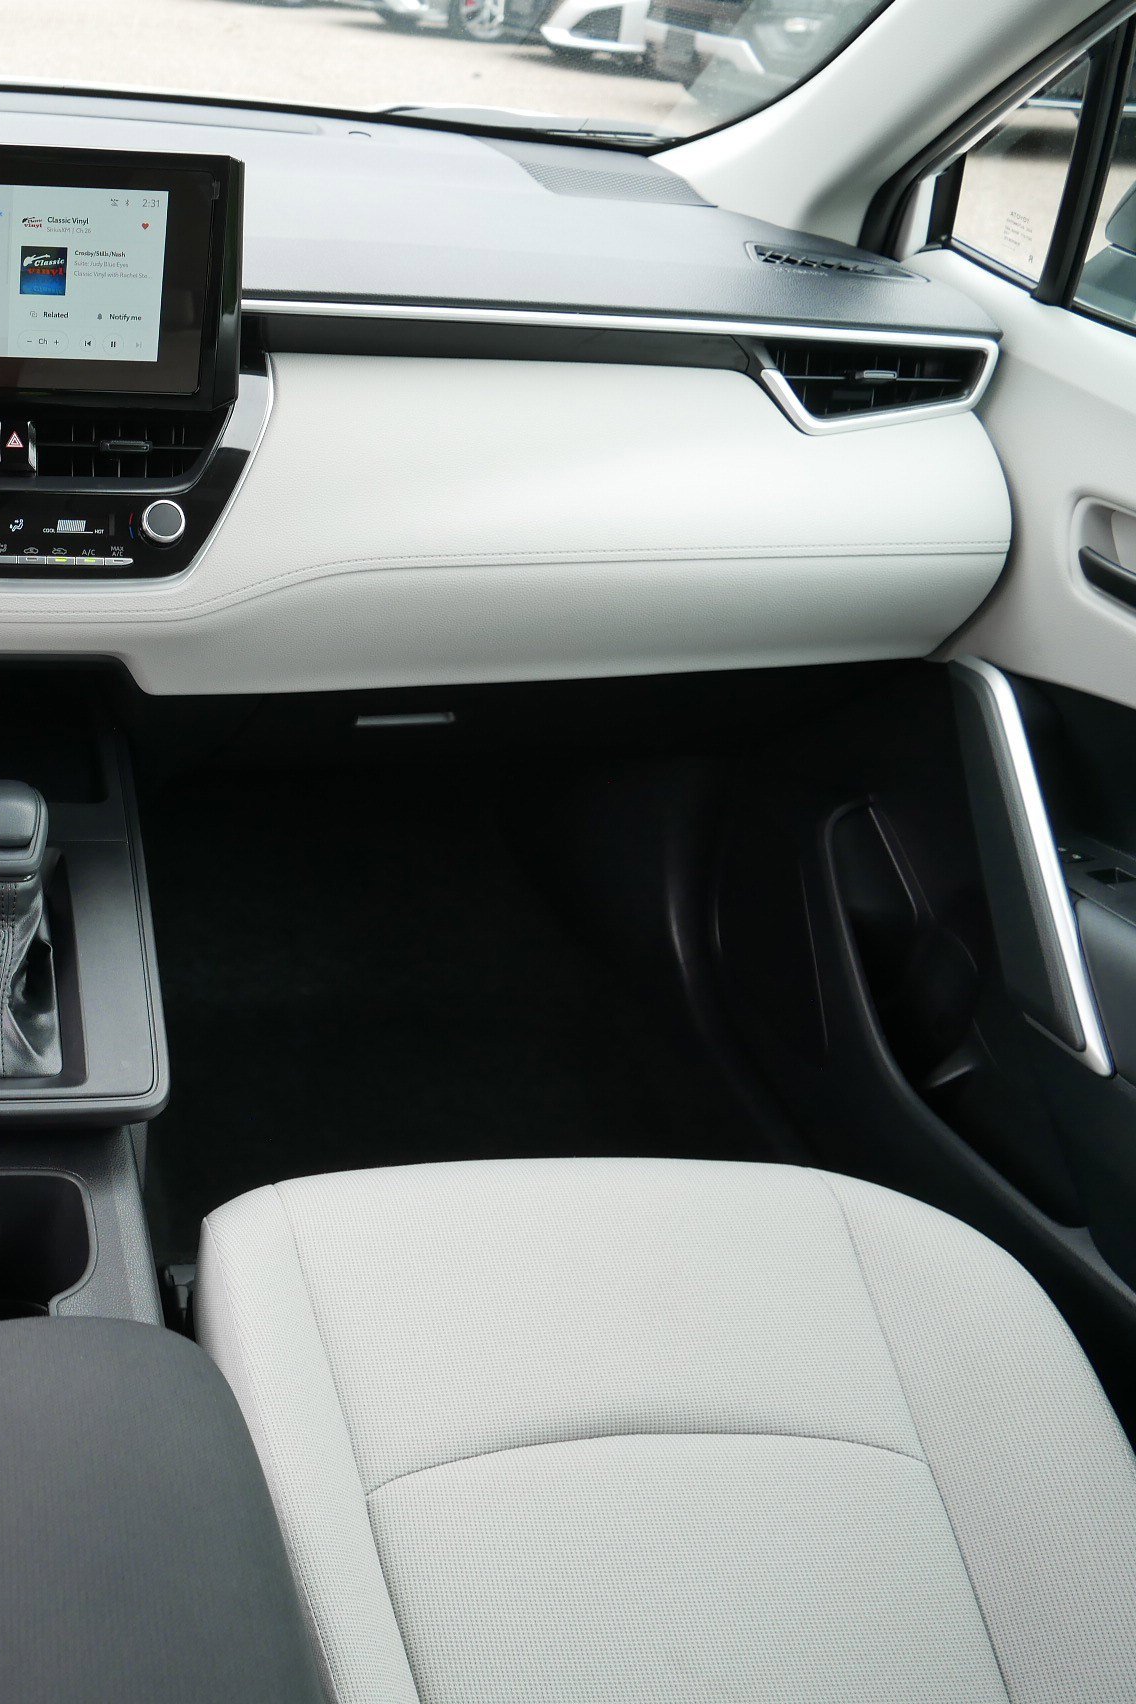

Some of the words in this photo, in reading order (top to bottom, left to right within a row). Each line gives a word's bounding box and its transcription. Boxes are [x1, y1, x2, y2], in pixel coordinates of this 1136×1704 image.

[142, 198, 161, 208] 2:31
[47, 216, 71, 224] Classic
[72, 217, 89, 226] Vinyl
[34, 258, 65, 267] Classic
[43, 311, 69, 319] Related
[109, 313, 129, 322] Notify
